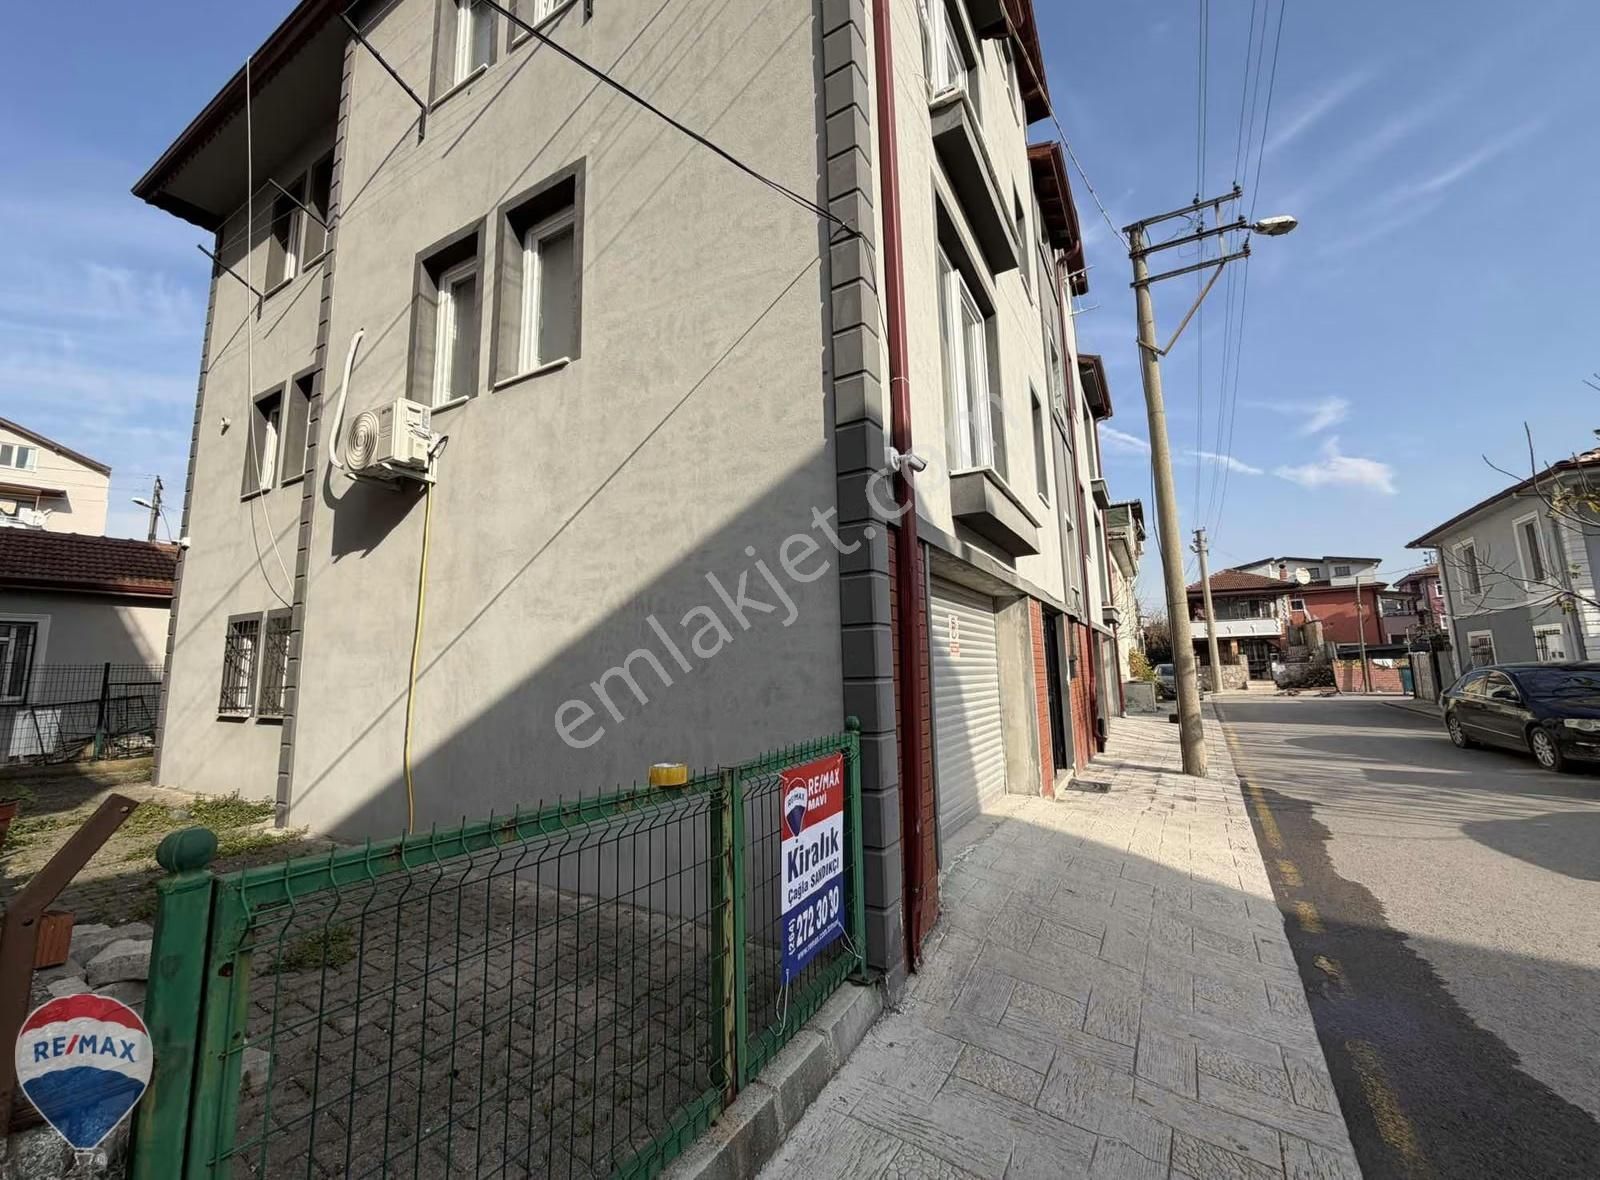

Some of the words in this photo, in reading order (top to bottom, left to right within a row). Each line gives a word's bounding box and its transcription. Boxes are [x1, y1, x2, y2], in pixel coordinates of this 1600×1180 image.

[808, 768, 839, 796] RE/MAX
[788, 827, 839, 883] Kiralık
[788, 881, 809, 907] Çağla
[796, 905, 814, 948] 272
[816, 895, 828, 930] 30
[828, 886, 839, 919] 30
